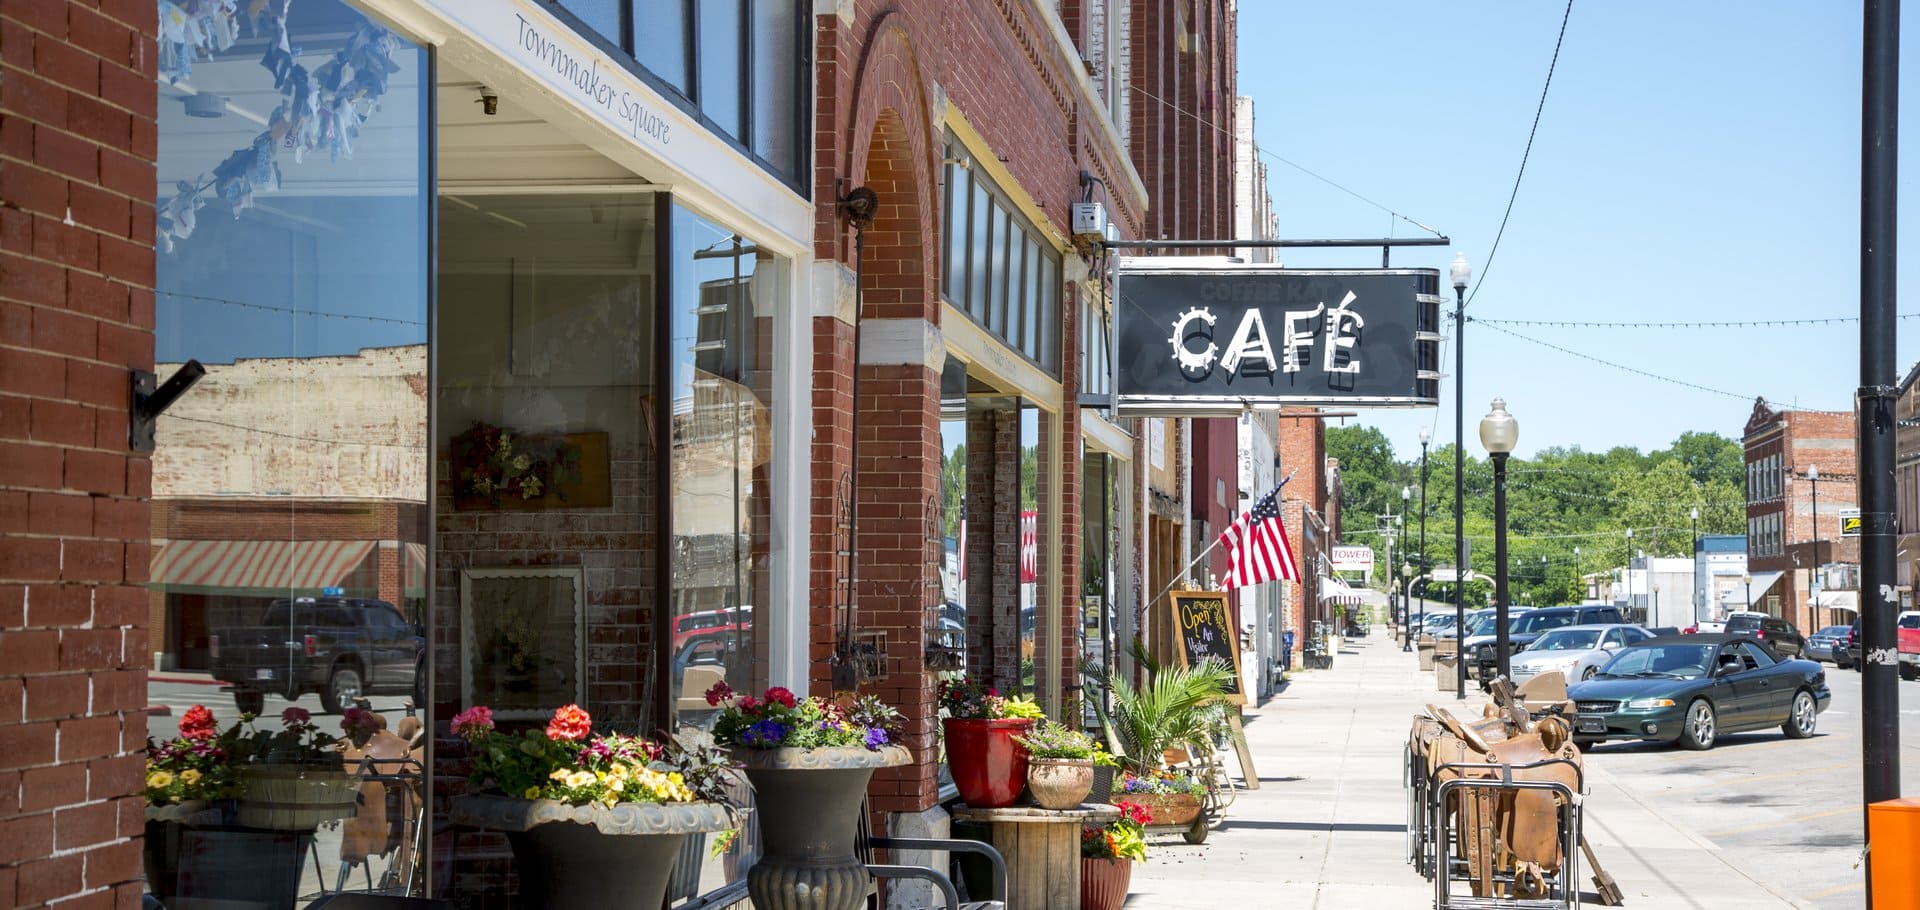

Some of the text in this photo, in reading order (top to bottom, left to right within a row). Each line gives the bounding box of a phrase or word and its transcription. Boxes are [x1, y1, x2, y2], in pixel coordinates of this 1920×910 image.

[515, 13, 671, 145] Townmaker Square
[1168, 290, 1364, 374] CAFÉ
[1333, 550, 1370, 559] TOWER
[1182, 604, 1212, 639] Open
